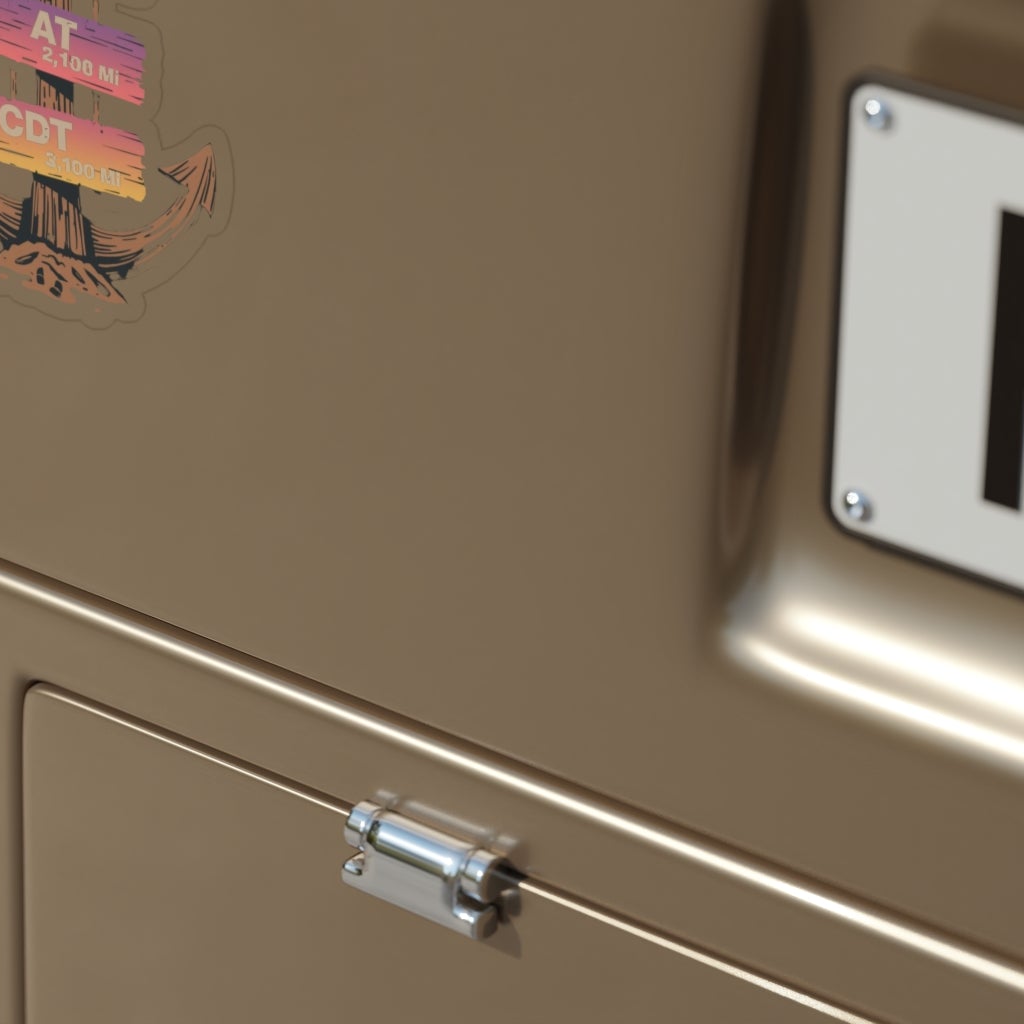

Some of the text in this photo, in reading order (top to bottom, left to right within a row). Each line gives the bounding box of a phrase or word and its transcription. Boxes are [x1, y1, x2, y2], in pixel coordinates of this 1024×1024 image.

[29, 9, 78, 51] AT
[98, 64, 120, 87] Mi
[45, 151, 121, 187] 3,100 Mi
